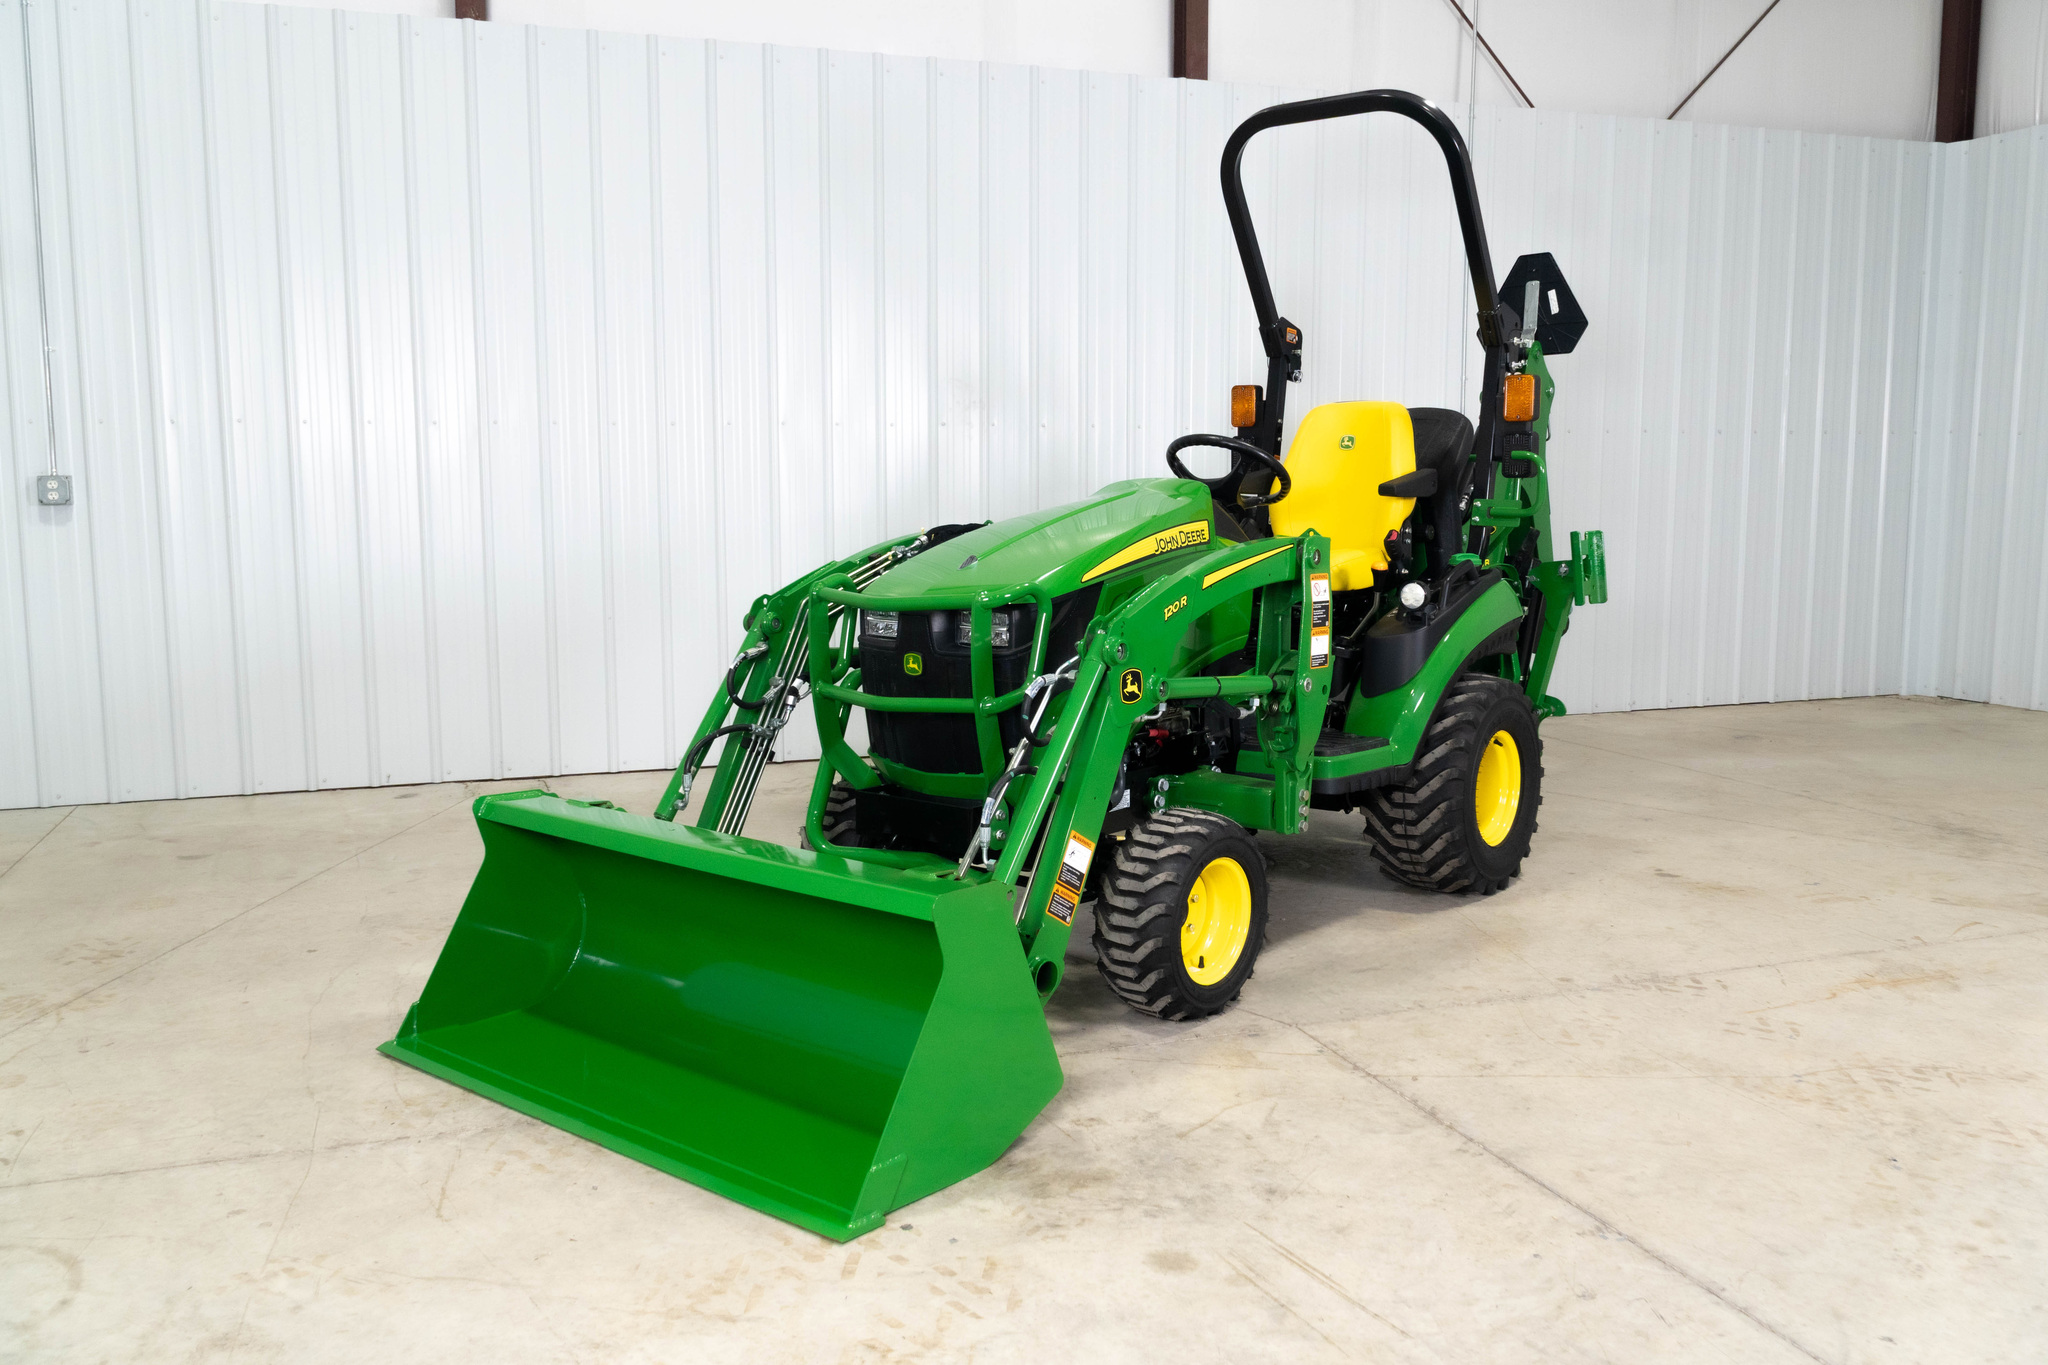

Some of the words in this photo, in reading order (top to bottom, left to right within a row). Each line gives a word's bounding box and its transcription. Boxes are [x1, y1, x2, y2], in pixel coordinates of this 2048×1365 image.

[1154, 534, 1179, 552] JOHN
[1178, 529, 1206, 545] DEERE
[1164, 601, 1180, 622] 120
[1180, 595, 1188, 609] R
